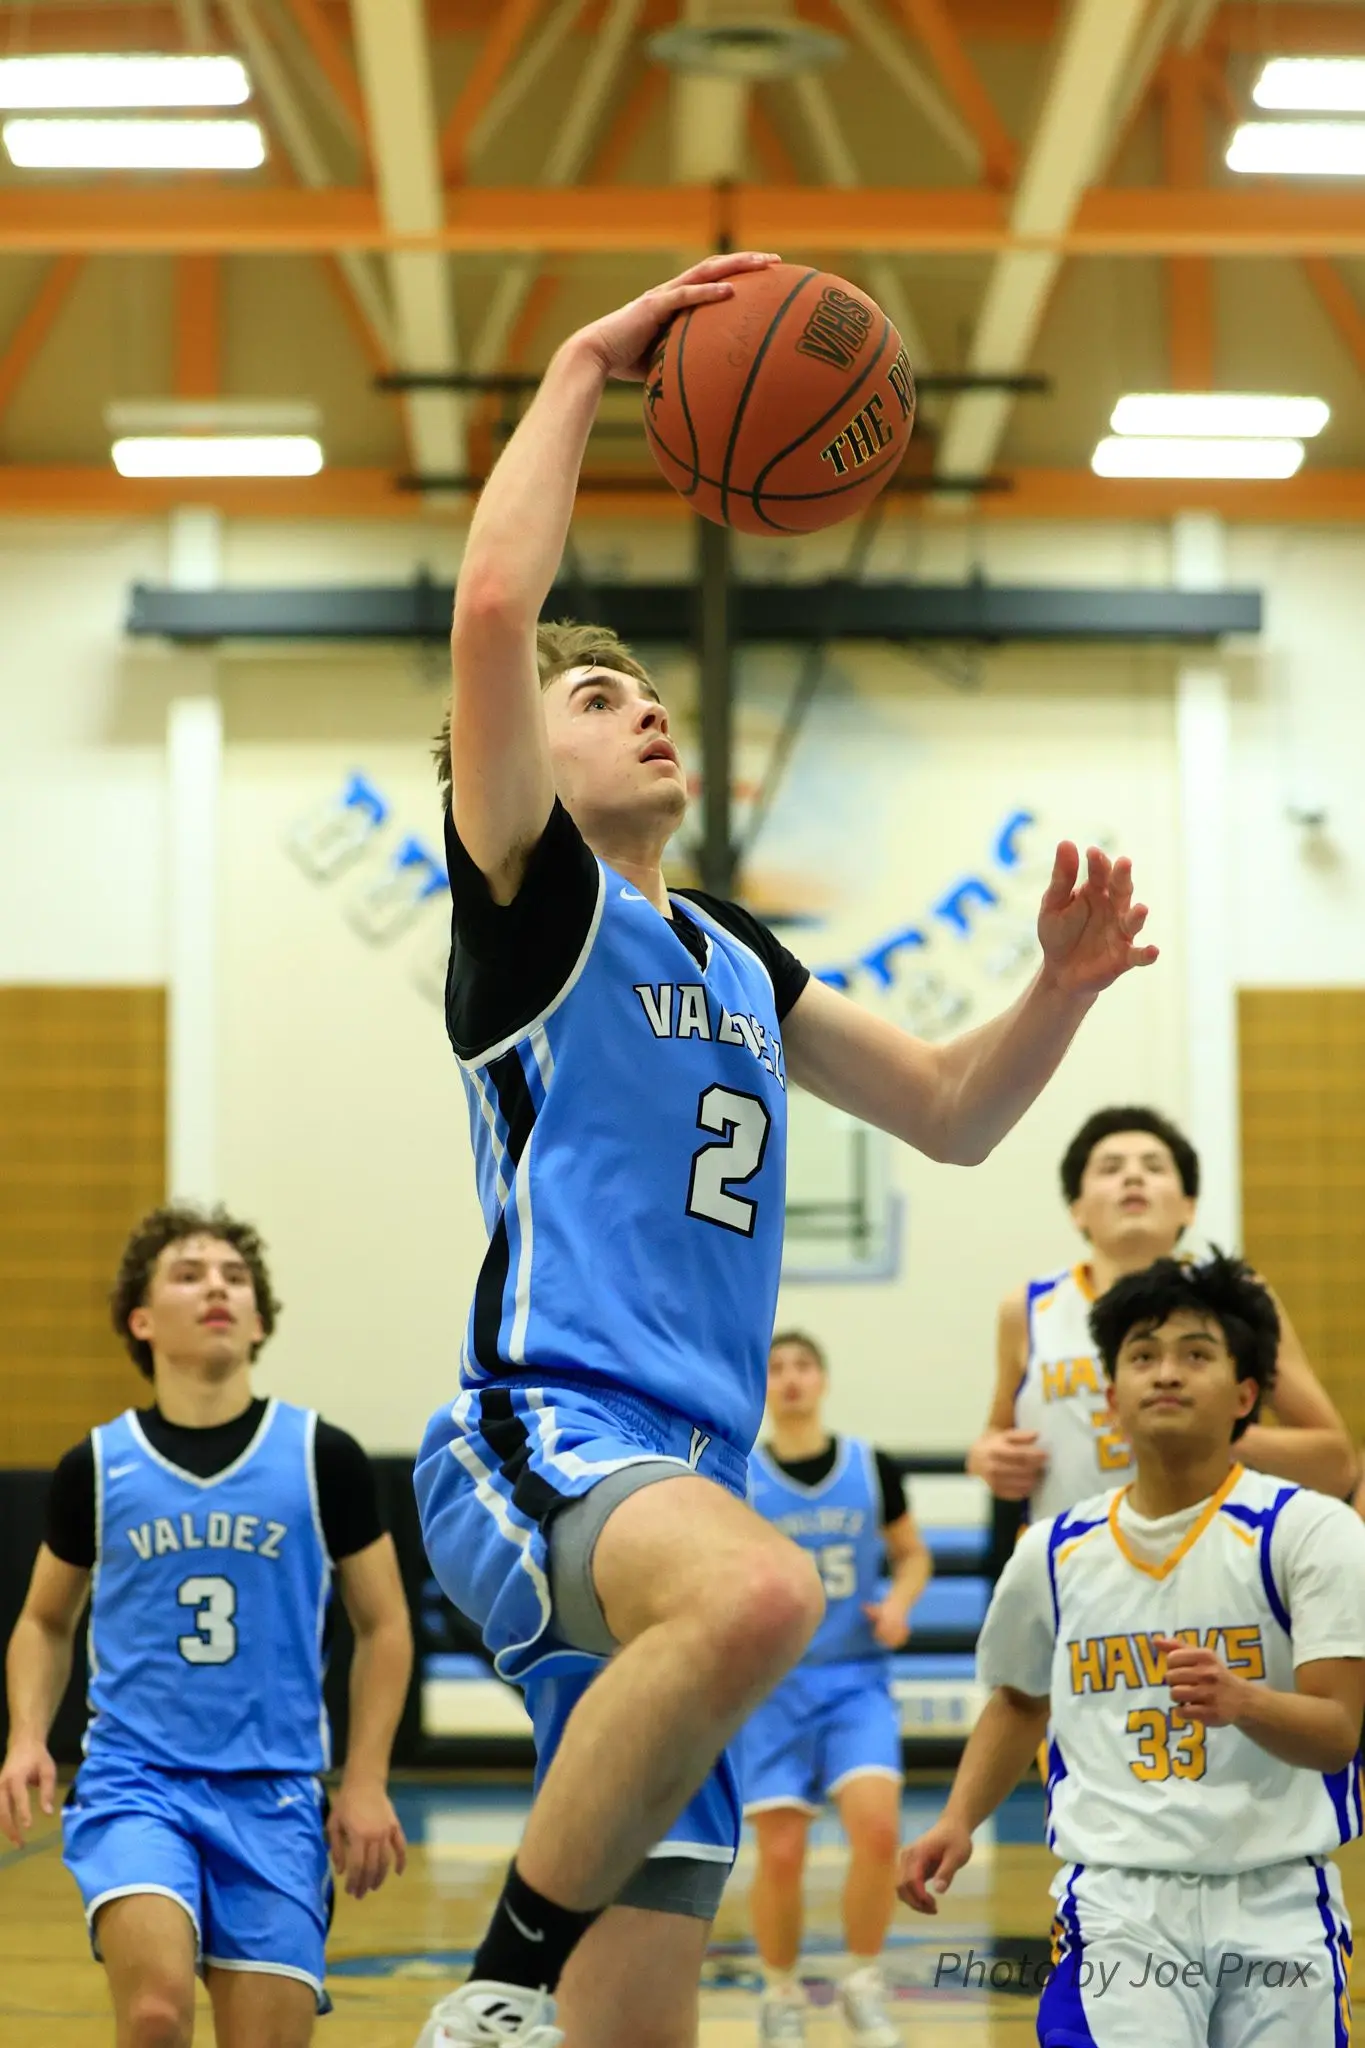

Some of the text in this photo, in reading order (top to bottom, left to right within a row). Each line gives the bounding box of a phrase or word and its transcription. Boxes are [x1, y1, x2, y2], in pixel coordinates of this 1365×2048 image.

[796, 286, 874, 373] VHS
[820, 391, 894, 477] THE
[685, 1081, 772, 1239] 2
[1041, 1356, 1101, 1405] HA
[126, 1510, 289, 1561] VALDEZ
[177, 1573, 238, 1667] 3
[1126, 1707, 1207, 1783] 33
